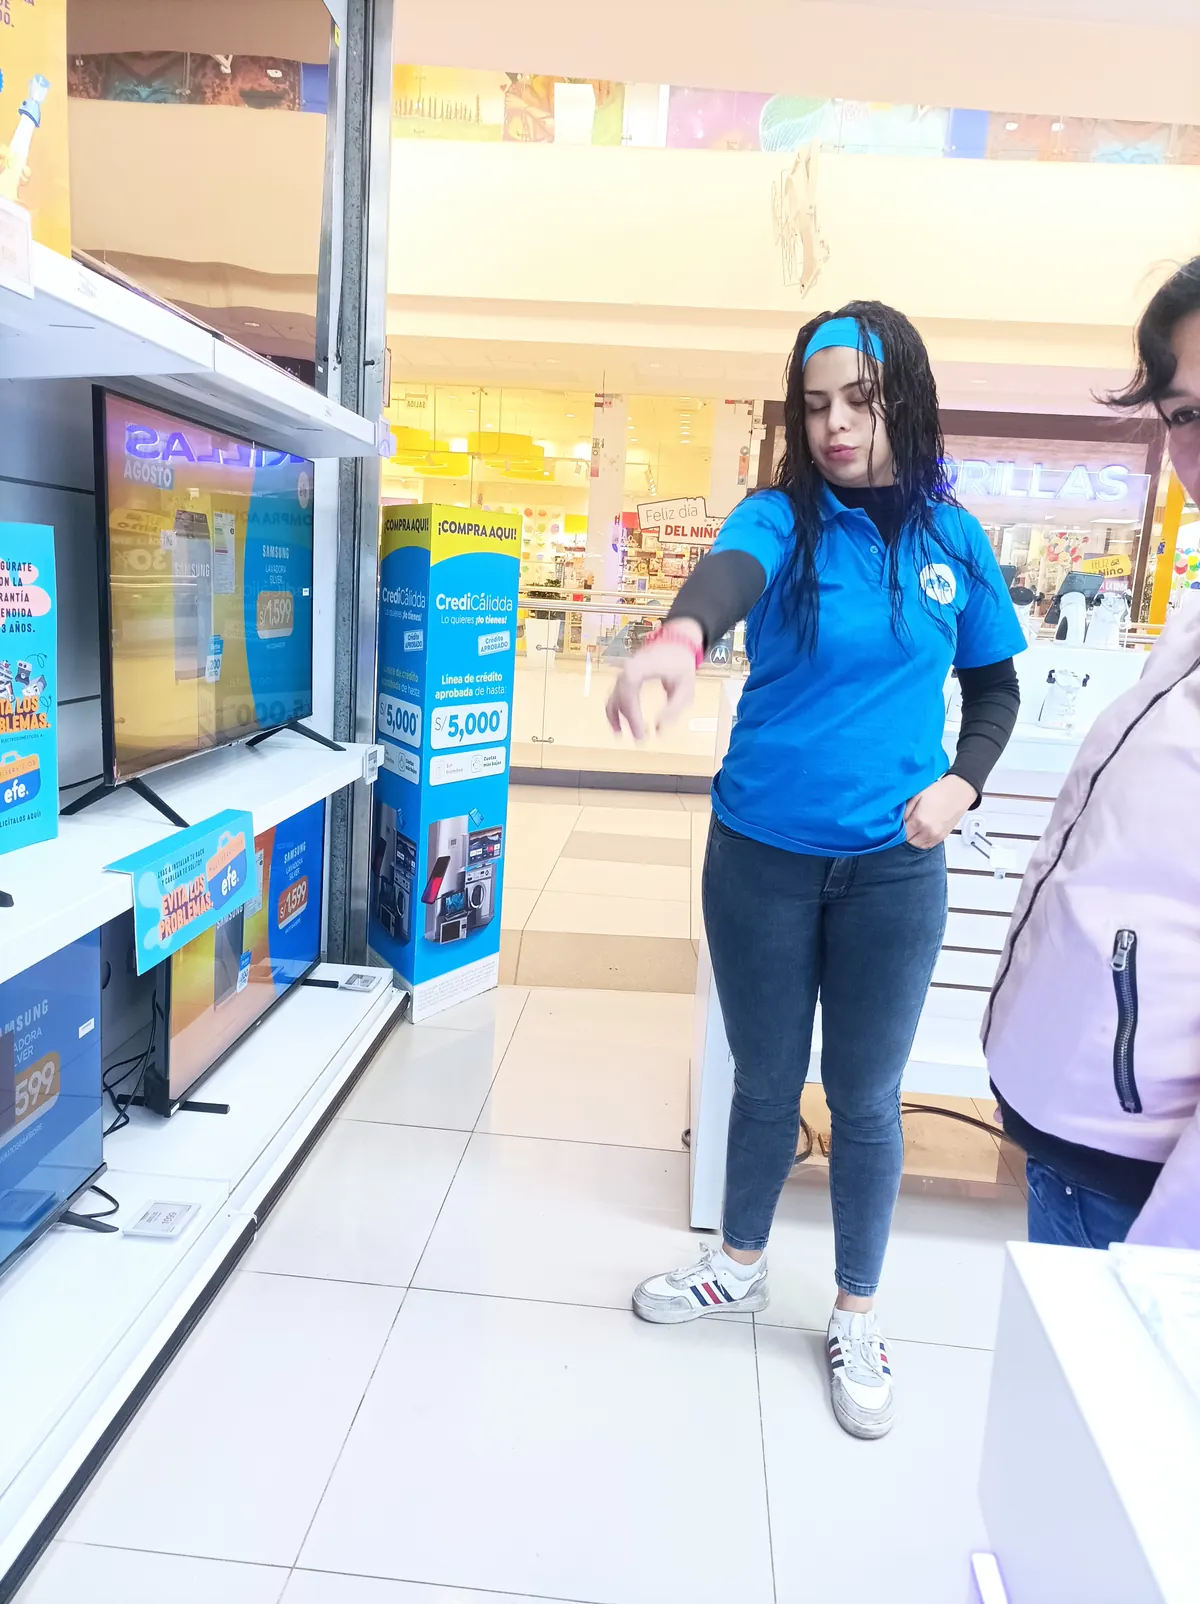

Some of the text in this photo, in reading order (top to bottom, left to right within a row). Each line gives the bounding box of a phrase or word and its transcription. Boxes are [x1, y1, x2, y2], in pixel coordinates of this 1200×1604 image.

[123, 462, 173, 488] AGOSTO
[645, 503, 698, 522] Feliz día
[438, 519, 517, 541] ¡COMPRA AQUI!
[664, 525, 688, 537] DEL
[262, 544, 290, 560] SAMSUNG
[13, 577, 23, 586] LA
[382, 587, 426, 609] CrediCálidda
[435, 592, 513, 612] CrediCálidda
[1, 621, 36, 633] 3 AÑOS.
[440, 615, 449, 624] Lo
[450, 615, 475, 626] quieres
[485, 614, 508, 624] tienes!
[480, 641, 509, 653] APROBADO
[485, 635, 504, 645] Crédito
[441, 671, 503, 685] Línea de crédito
[434, 687, 473, 701] aprobada
[474, 687, 485, 696] de
[15, 696, 39, 715] LOS
[284, 841, 306, 864] SAMSUNG
[171, 856, 190, 872] INSTALAR
[285, 859, 304, 875] LAVADORA
[165, 870, 182, 885] CABLEAR
[289, 868, 301, 881] SILVER
[162, 873, 205, 917] EVITA LOS
[158, 891, 214, 942] PROBLEMAS.
[15, 1061, 55, 1117] 599
